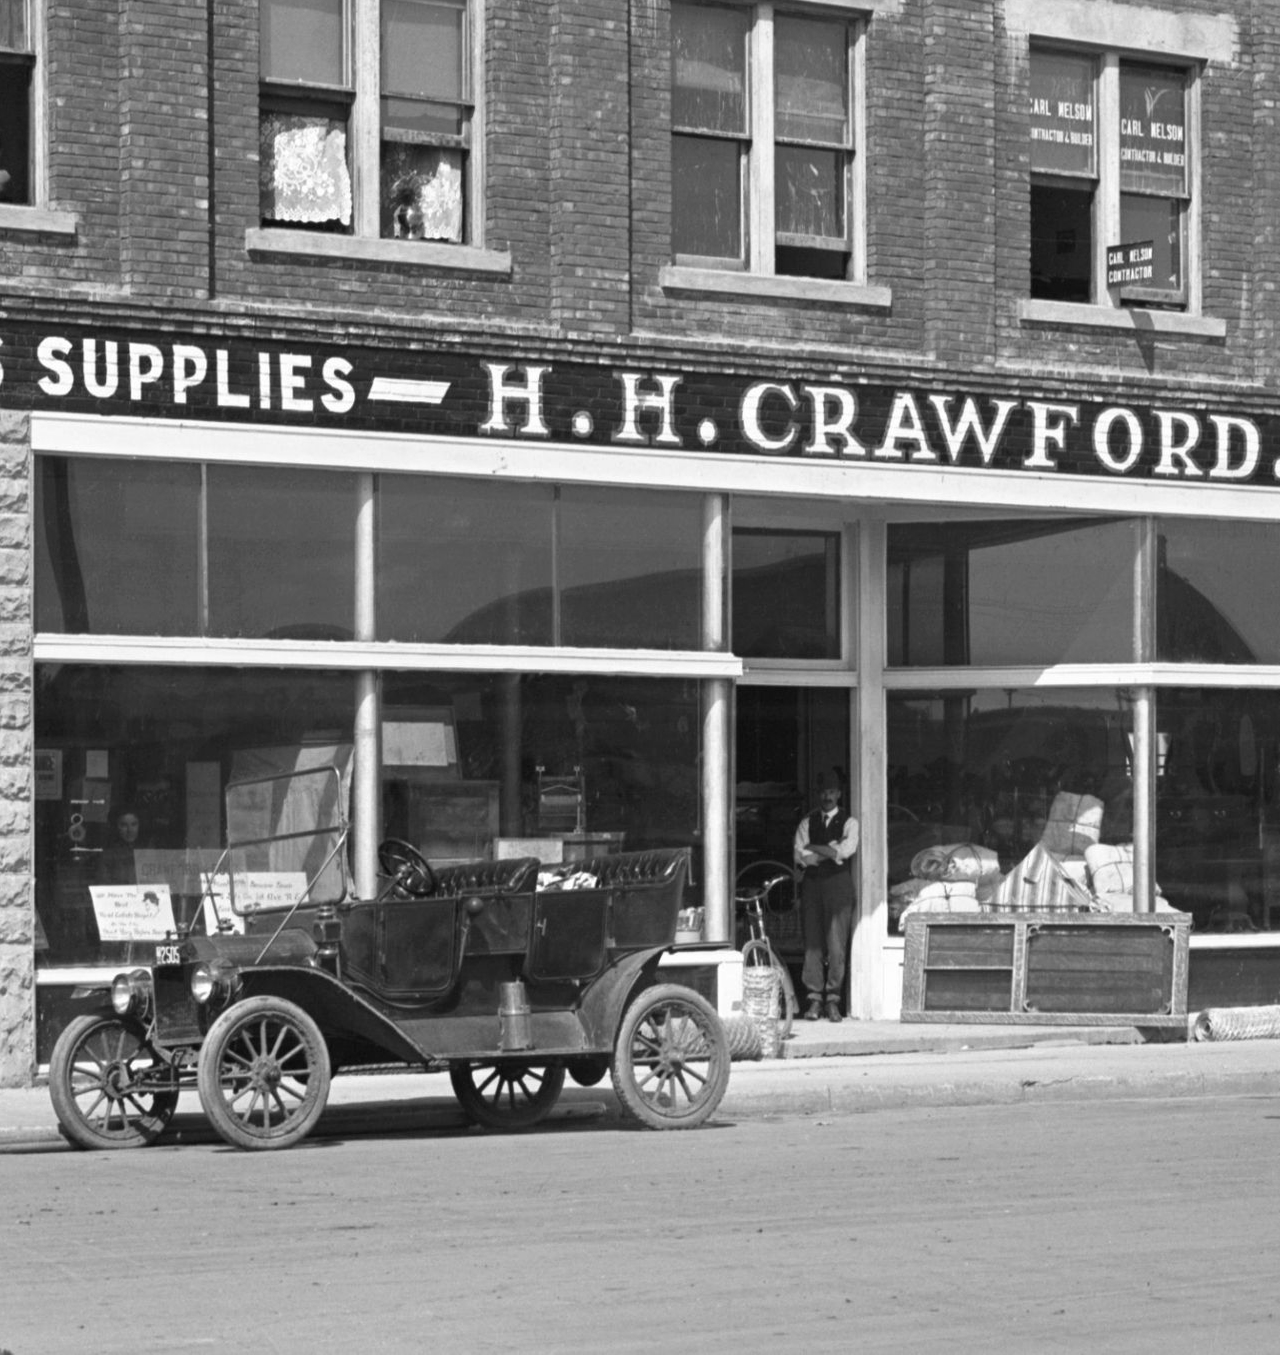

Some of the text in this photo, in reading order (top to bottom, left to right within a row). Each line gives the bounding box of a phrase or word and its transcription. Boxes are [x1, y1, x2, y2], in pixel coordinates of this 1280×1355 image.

[1058, 101, 1092, 122] NELSON
[1121, 118, 1184, 141] CARL NELSON
[1109, 247, 1153, 265] CARL NELSON
[1109, 265, 1153, 283] CONTRACTOR
[36, 336, 356, 414] SUPPLIES
